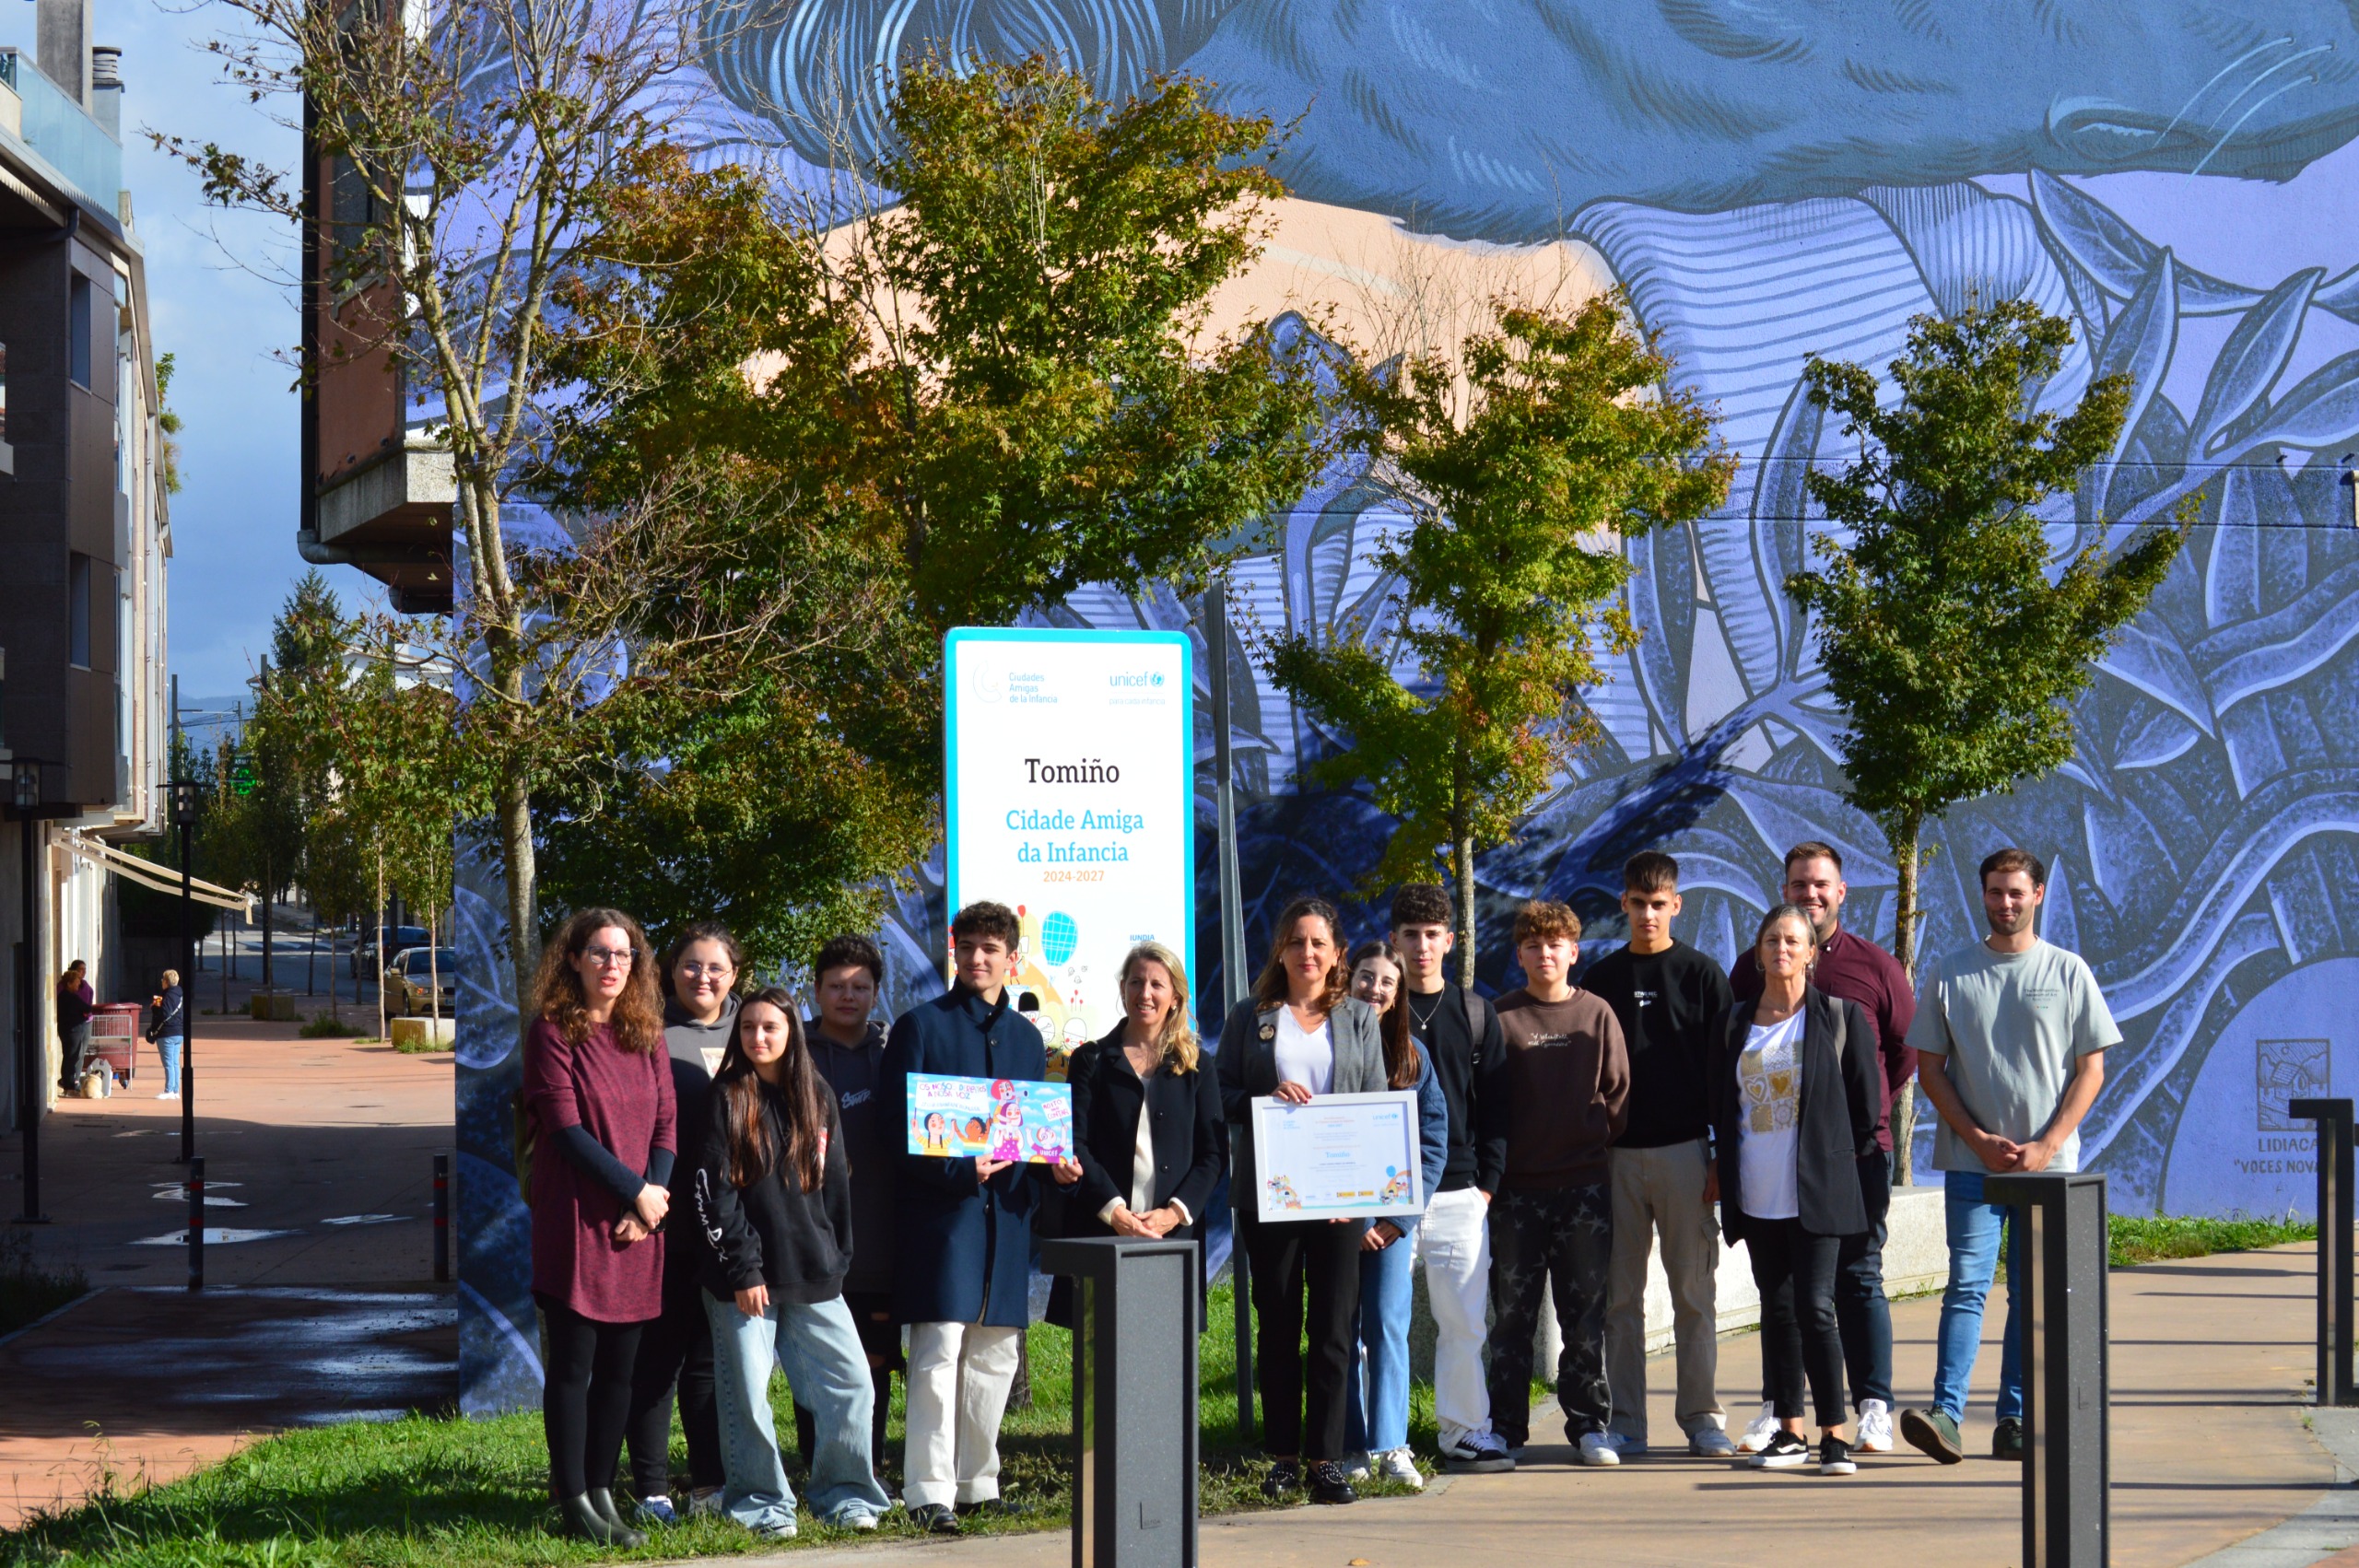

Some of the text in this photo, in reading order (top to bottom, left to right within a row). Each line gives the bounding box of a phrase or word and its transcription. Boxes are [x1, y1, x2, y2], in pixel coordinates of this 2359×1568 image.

[1008, 672, 1045, 682] Ciudades
[1109, 671, 1148, 687] unicef
[1009, 683, 1039, 695] Amigas
[1009, 694, 1058, 704] de la Infancia
[1109, 696, 1166, 706] para cada infancia
[1024, 757, 1120, 783] Tomiño
[1005, 809, 1144, 834] Cidade Amiga
[1017, 841, 1129, 862] da Infancia
[1043, 870, 1105, 882] 2024-2027
[1130, 933, 1155, 942] IUNDIA
